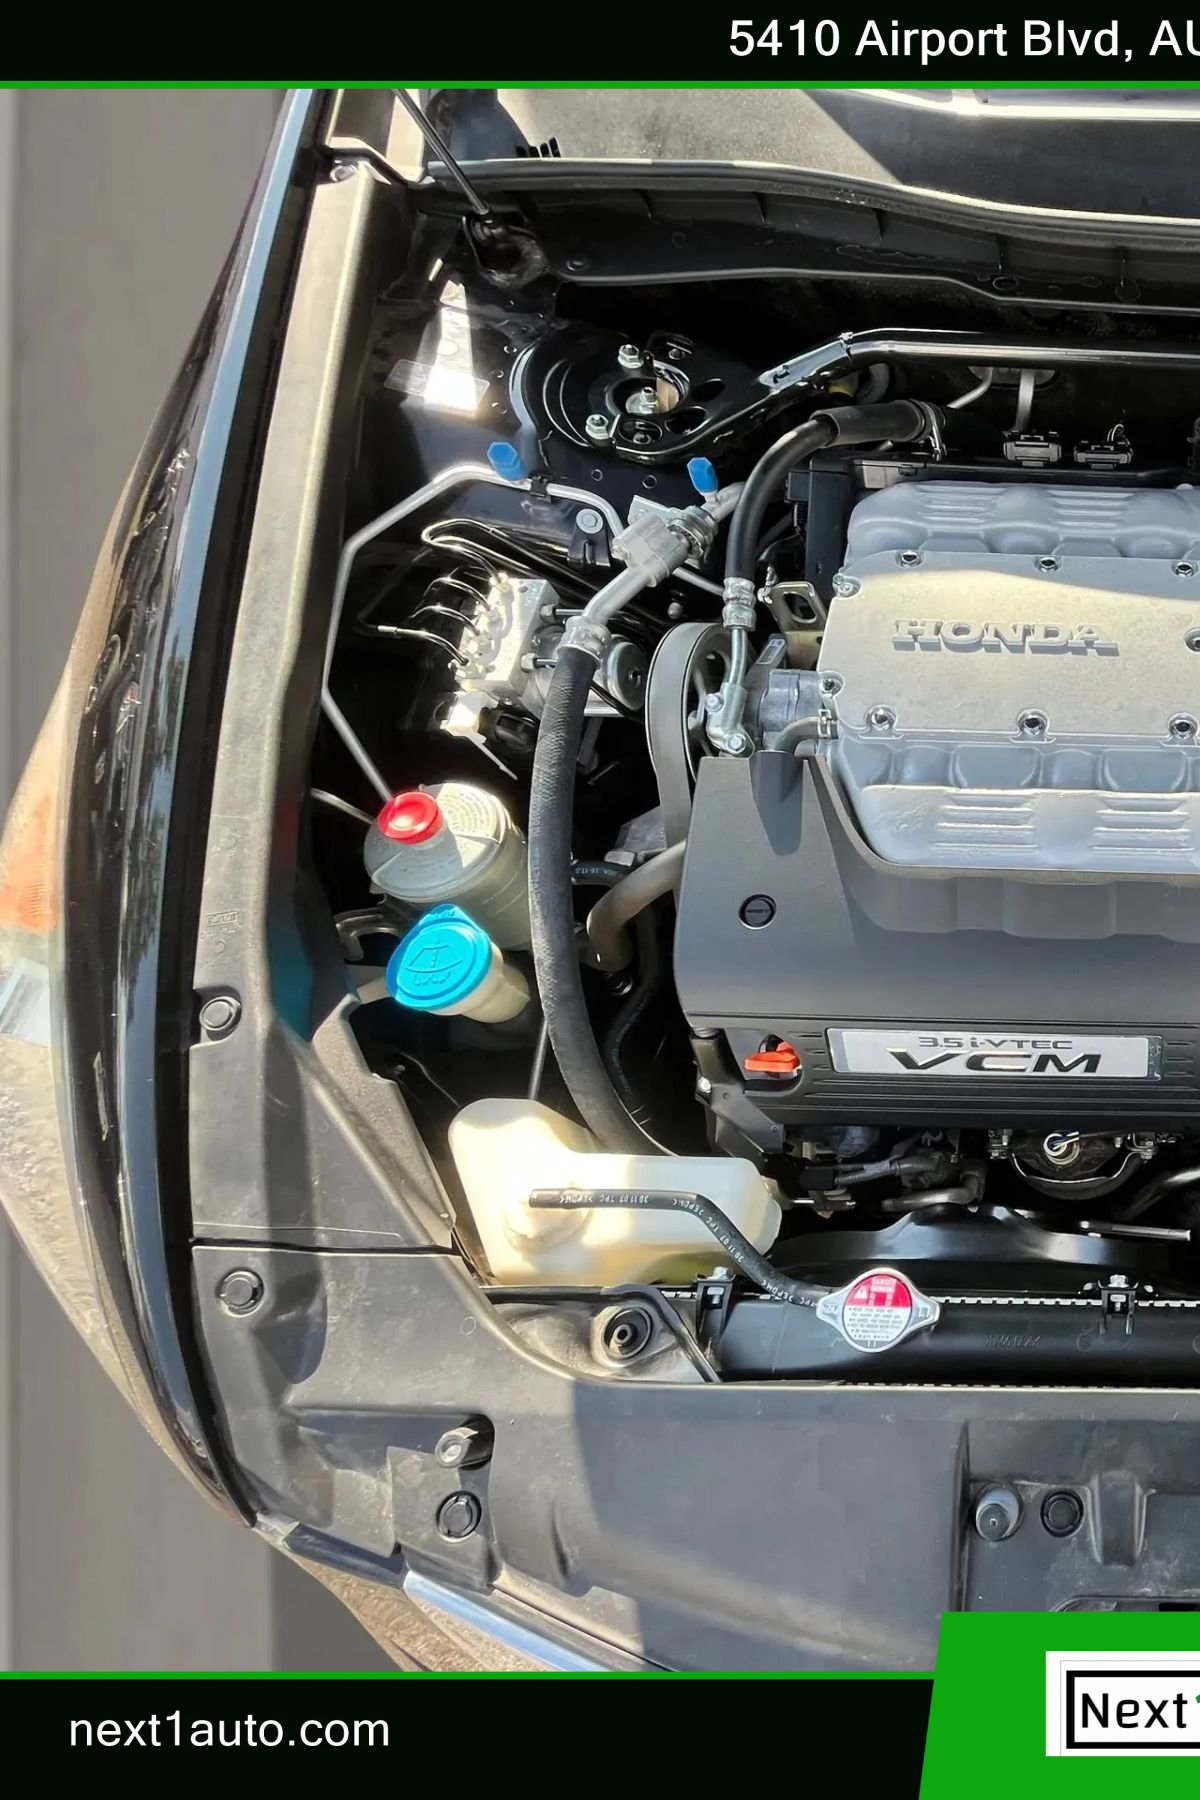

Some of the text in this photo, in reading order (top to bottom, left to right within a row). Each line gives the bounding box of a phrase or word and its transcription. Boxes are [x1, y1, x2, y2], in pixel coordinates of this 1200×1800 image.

[892, 619, 1120, 656] HONDA
[918, 1036, 1073, 1050] 3.5 i-VTEC
[885, 1047, 1102, 1073] VCM
